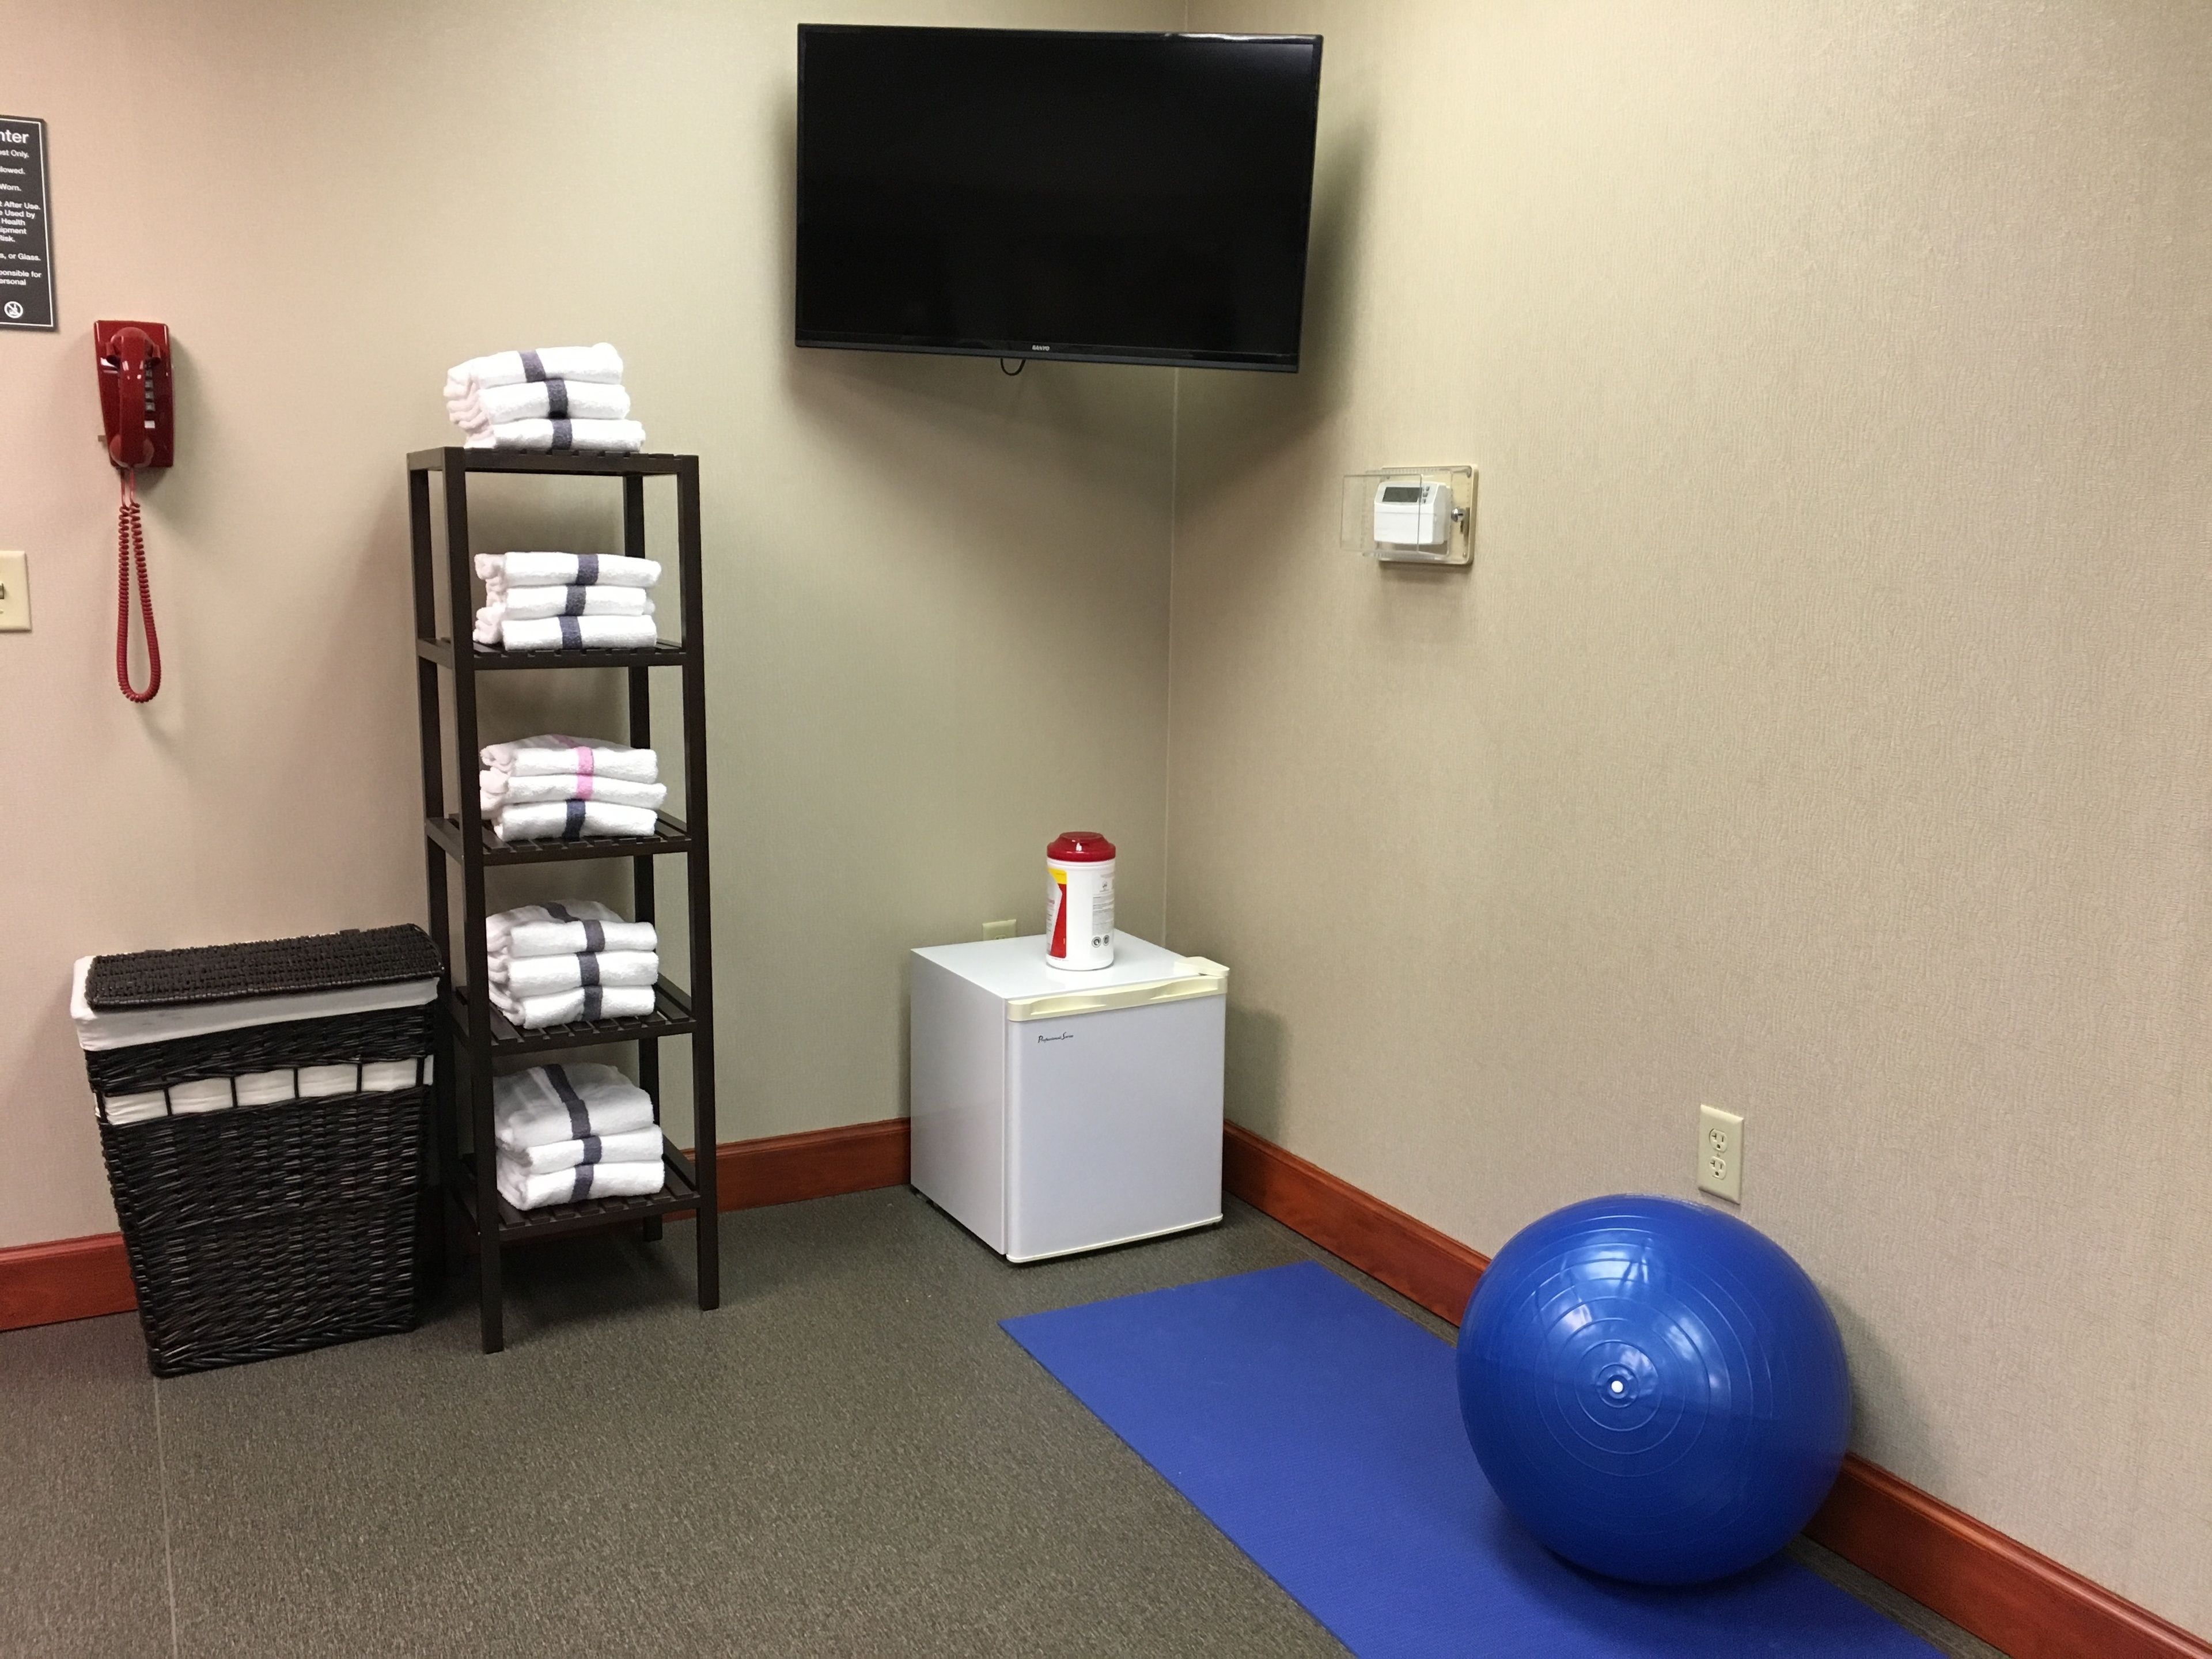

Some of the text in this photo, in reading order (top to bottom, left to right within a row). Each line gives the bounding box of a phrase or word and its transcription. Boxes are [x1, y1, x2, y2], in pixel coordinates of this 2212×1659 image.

[10, 150, 29, 159] Only.
[5, 209, 24, 217] Used
[26, 211, 35, 219] by
[1, 218, 26, 226] Health
[18, 253, 41, 261] Glass.
